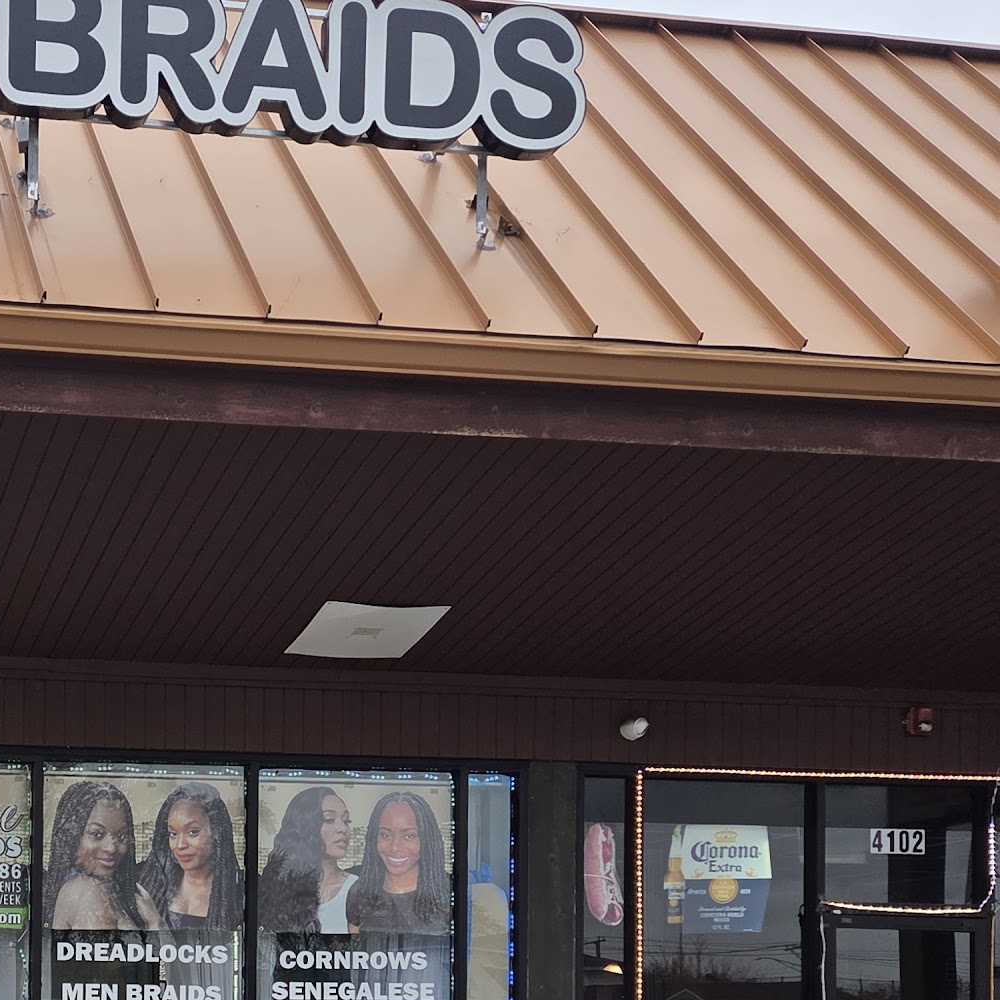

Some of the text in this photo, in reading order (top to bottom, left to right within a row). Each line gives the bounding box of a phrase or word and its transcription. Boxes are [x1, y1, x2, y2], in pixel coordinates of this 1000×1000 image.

[6, 0, 578, 141] BRAIDS
[690, 840, 760, 863] Corona
[872, 830, 924, 853] 4102
[705, 860, 743, 873] Extra
[56, 942, 228, 964] DREADLOCKS
[279, 950, 428, 970] CORNROWS
[271, 981, 435, 1000] SENEGALESE
